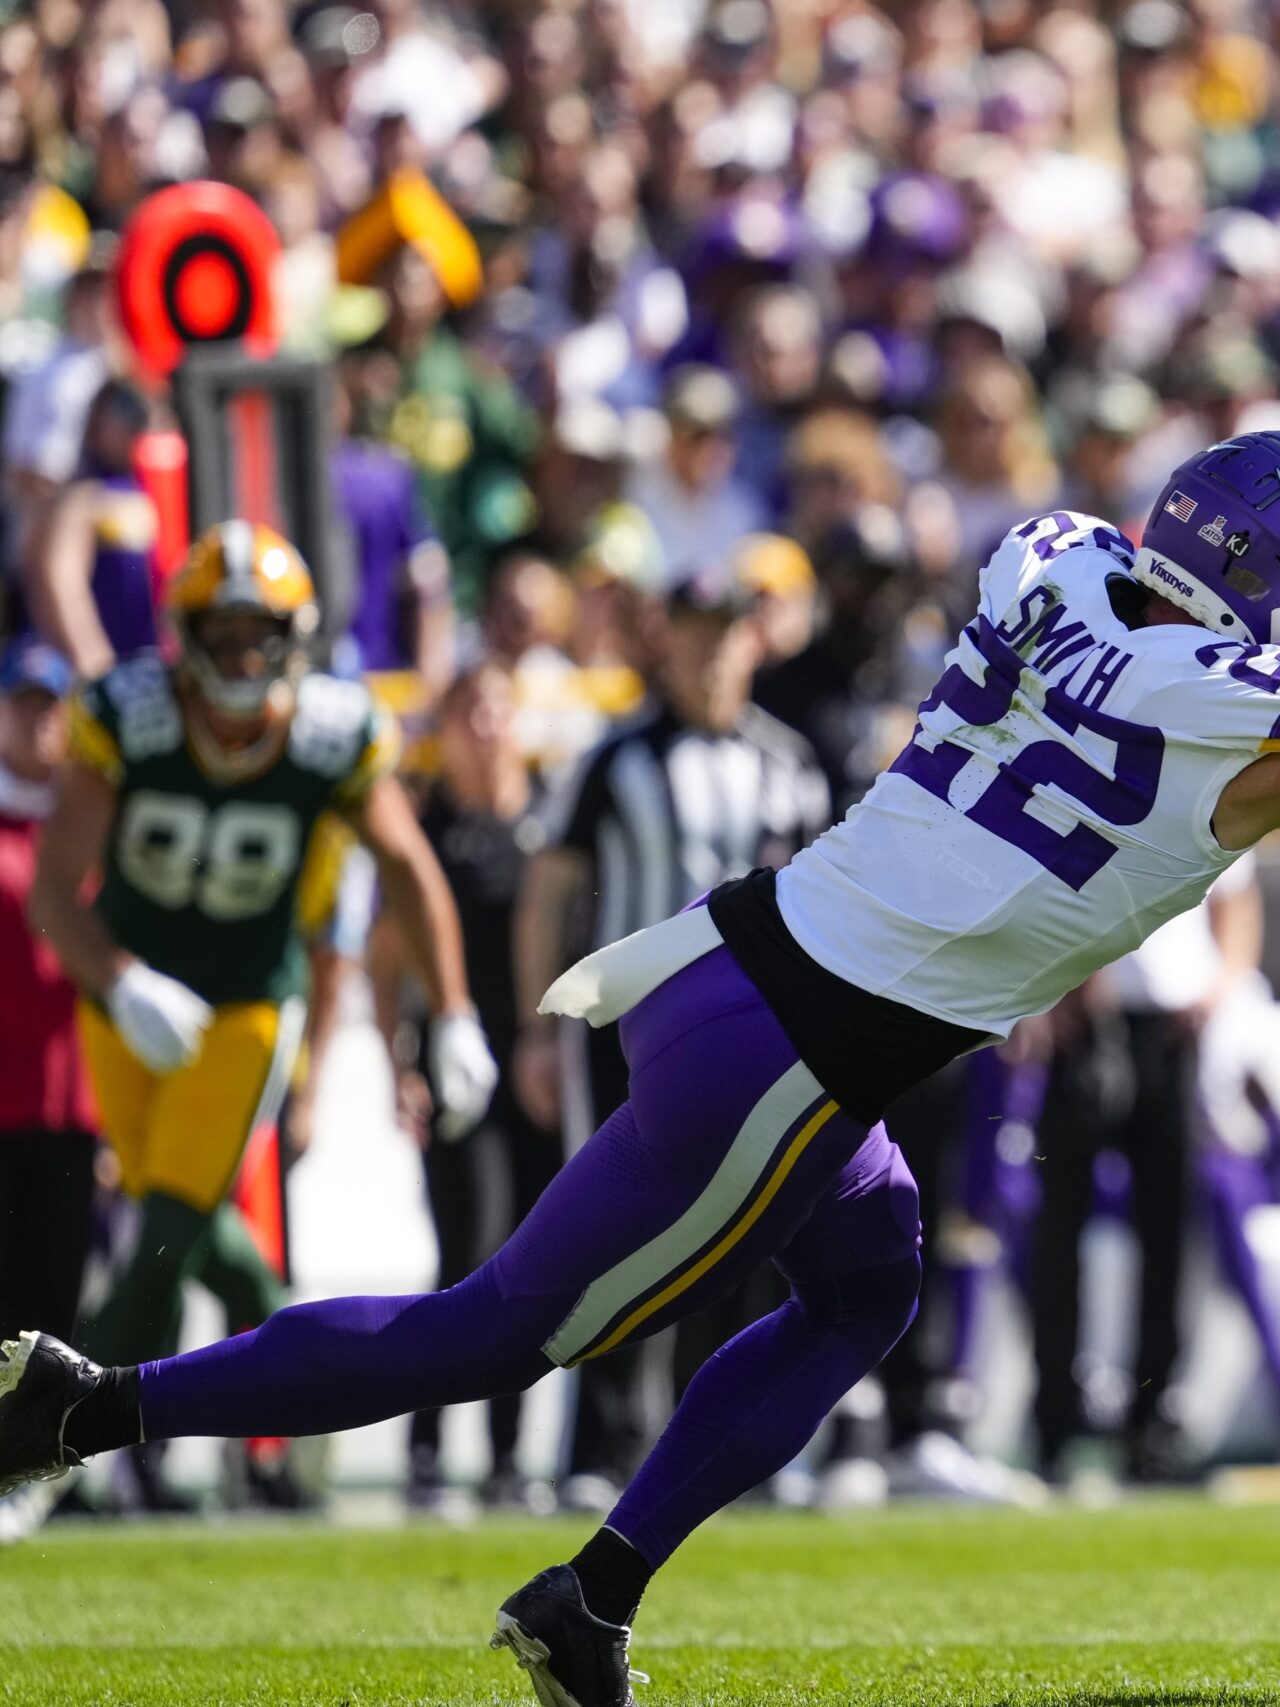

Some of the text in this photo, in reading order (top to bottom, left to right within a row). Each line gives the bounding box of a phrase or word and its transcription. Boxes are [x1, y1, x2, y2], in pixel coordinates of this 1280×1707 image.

[1201, 526, 1224, 545] CATCH
[1226, 535, 1248, 556] KJ
[889, 614, 1166, 893] 22
